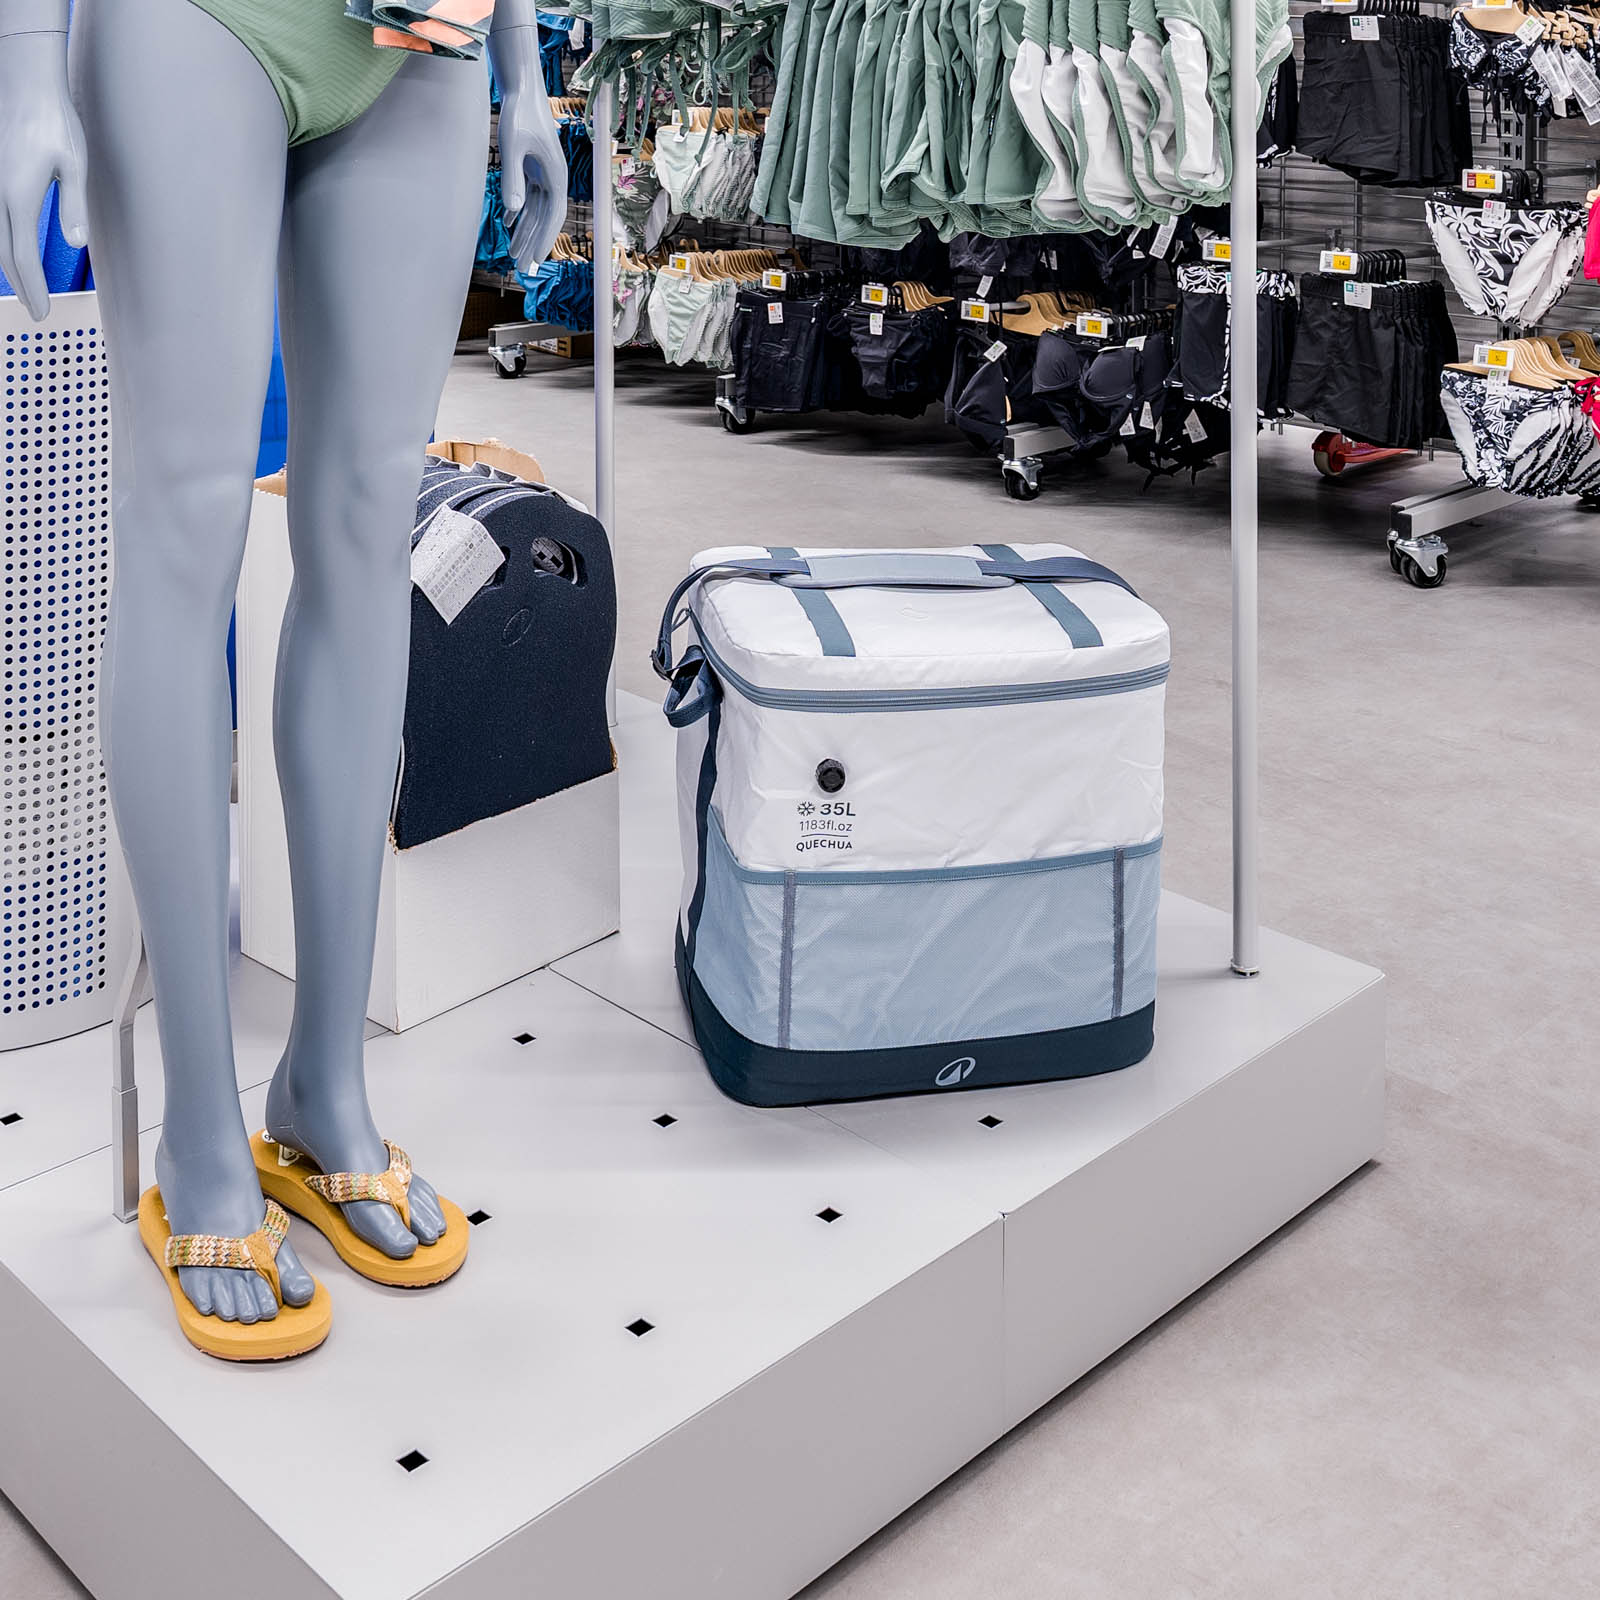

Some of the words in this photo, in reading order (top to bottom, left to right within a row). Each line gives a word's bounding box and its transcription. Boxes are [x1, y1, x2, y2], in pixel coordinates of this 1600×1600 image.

[820, 802, 856, 816] 35L
[799, 819, 853, 831] 1183fl.oz
[796, 839, 853, 852] QUECHUA
